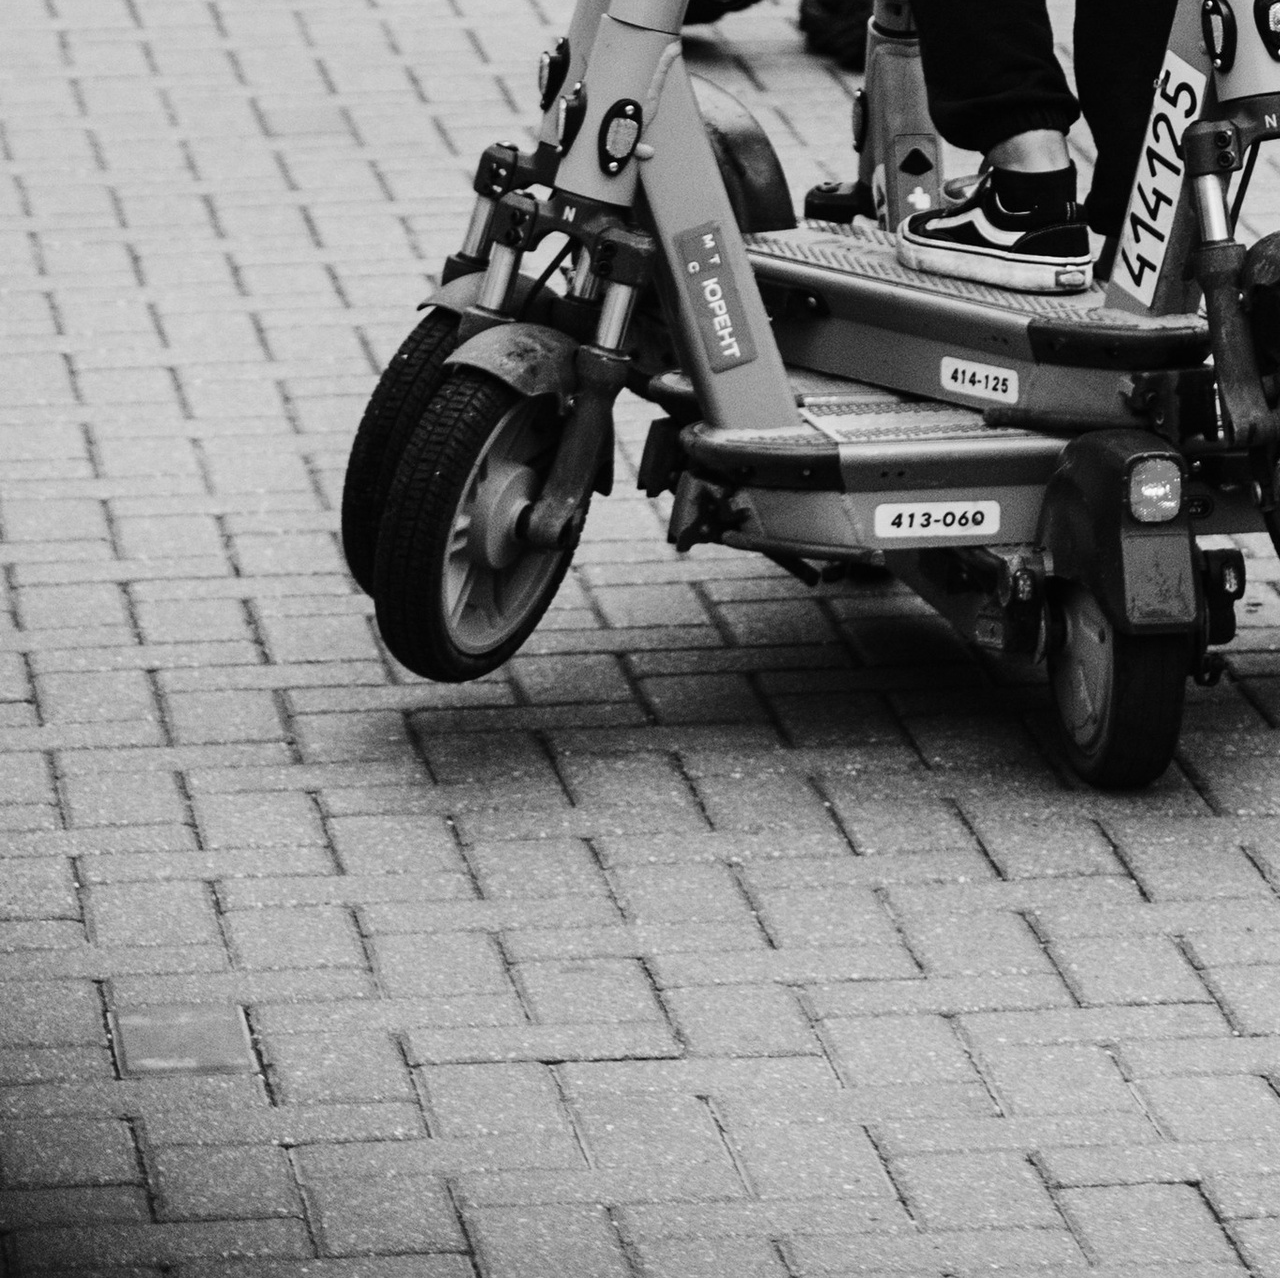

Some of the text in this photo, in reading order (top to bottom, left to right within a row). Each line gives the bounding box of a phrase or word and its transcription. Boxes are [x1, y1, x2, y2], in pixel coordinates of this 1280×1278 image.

[1121, 69, 1198, 288] 414125
[702, 277, 741, 357] ЮРЕНТ
[951, 368, 1009, 393] 414-125
[891, 510, 985, 529] 413-060
